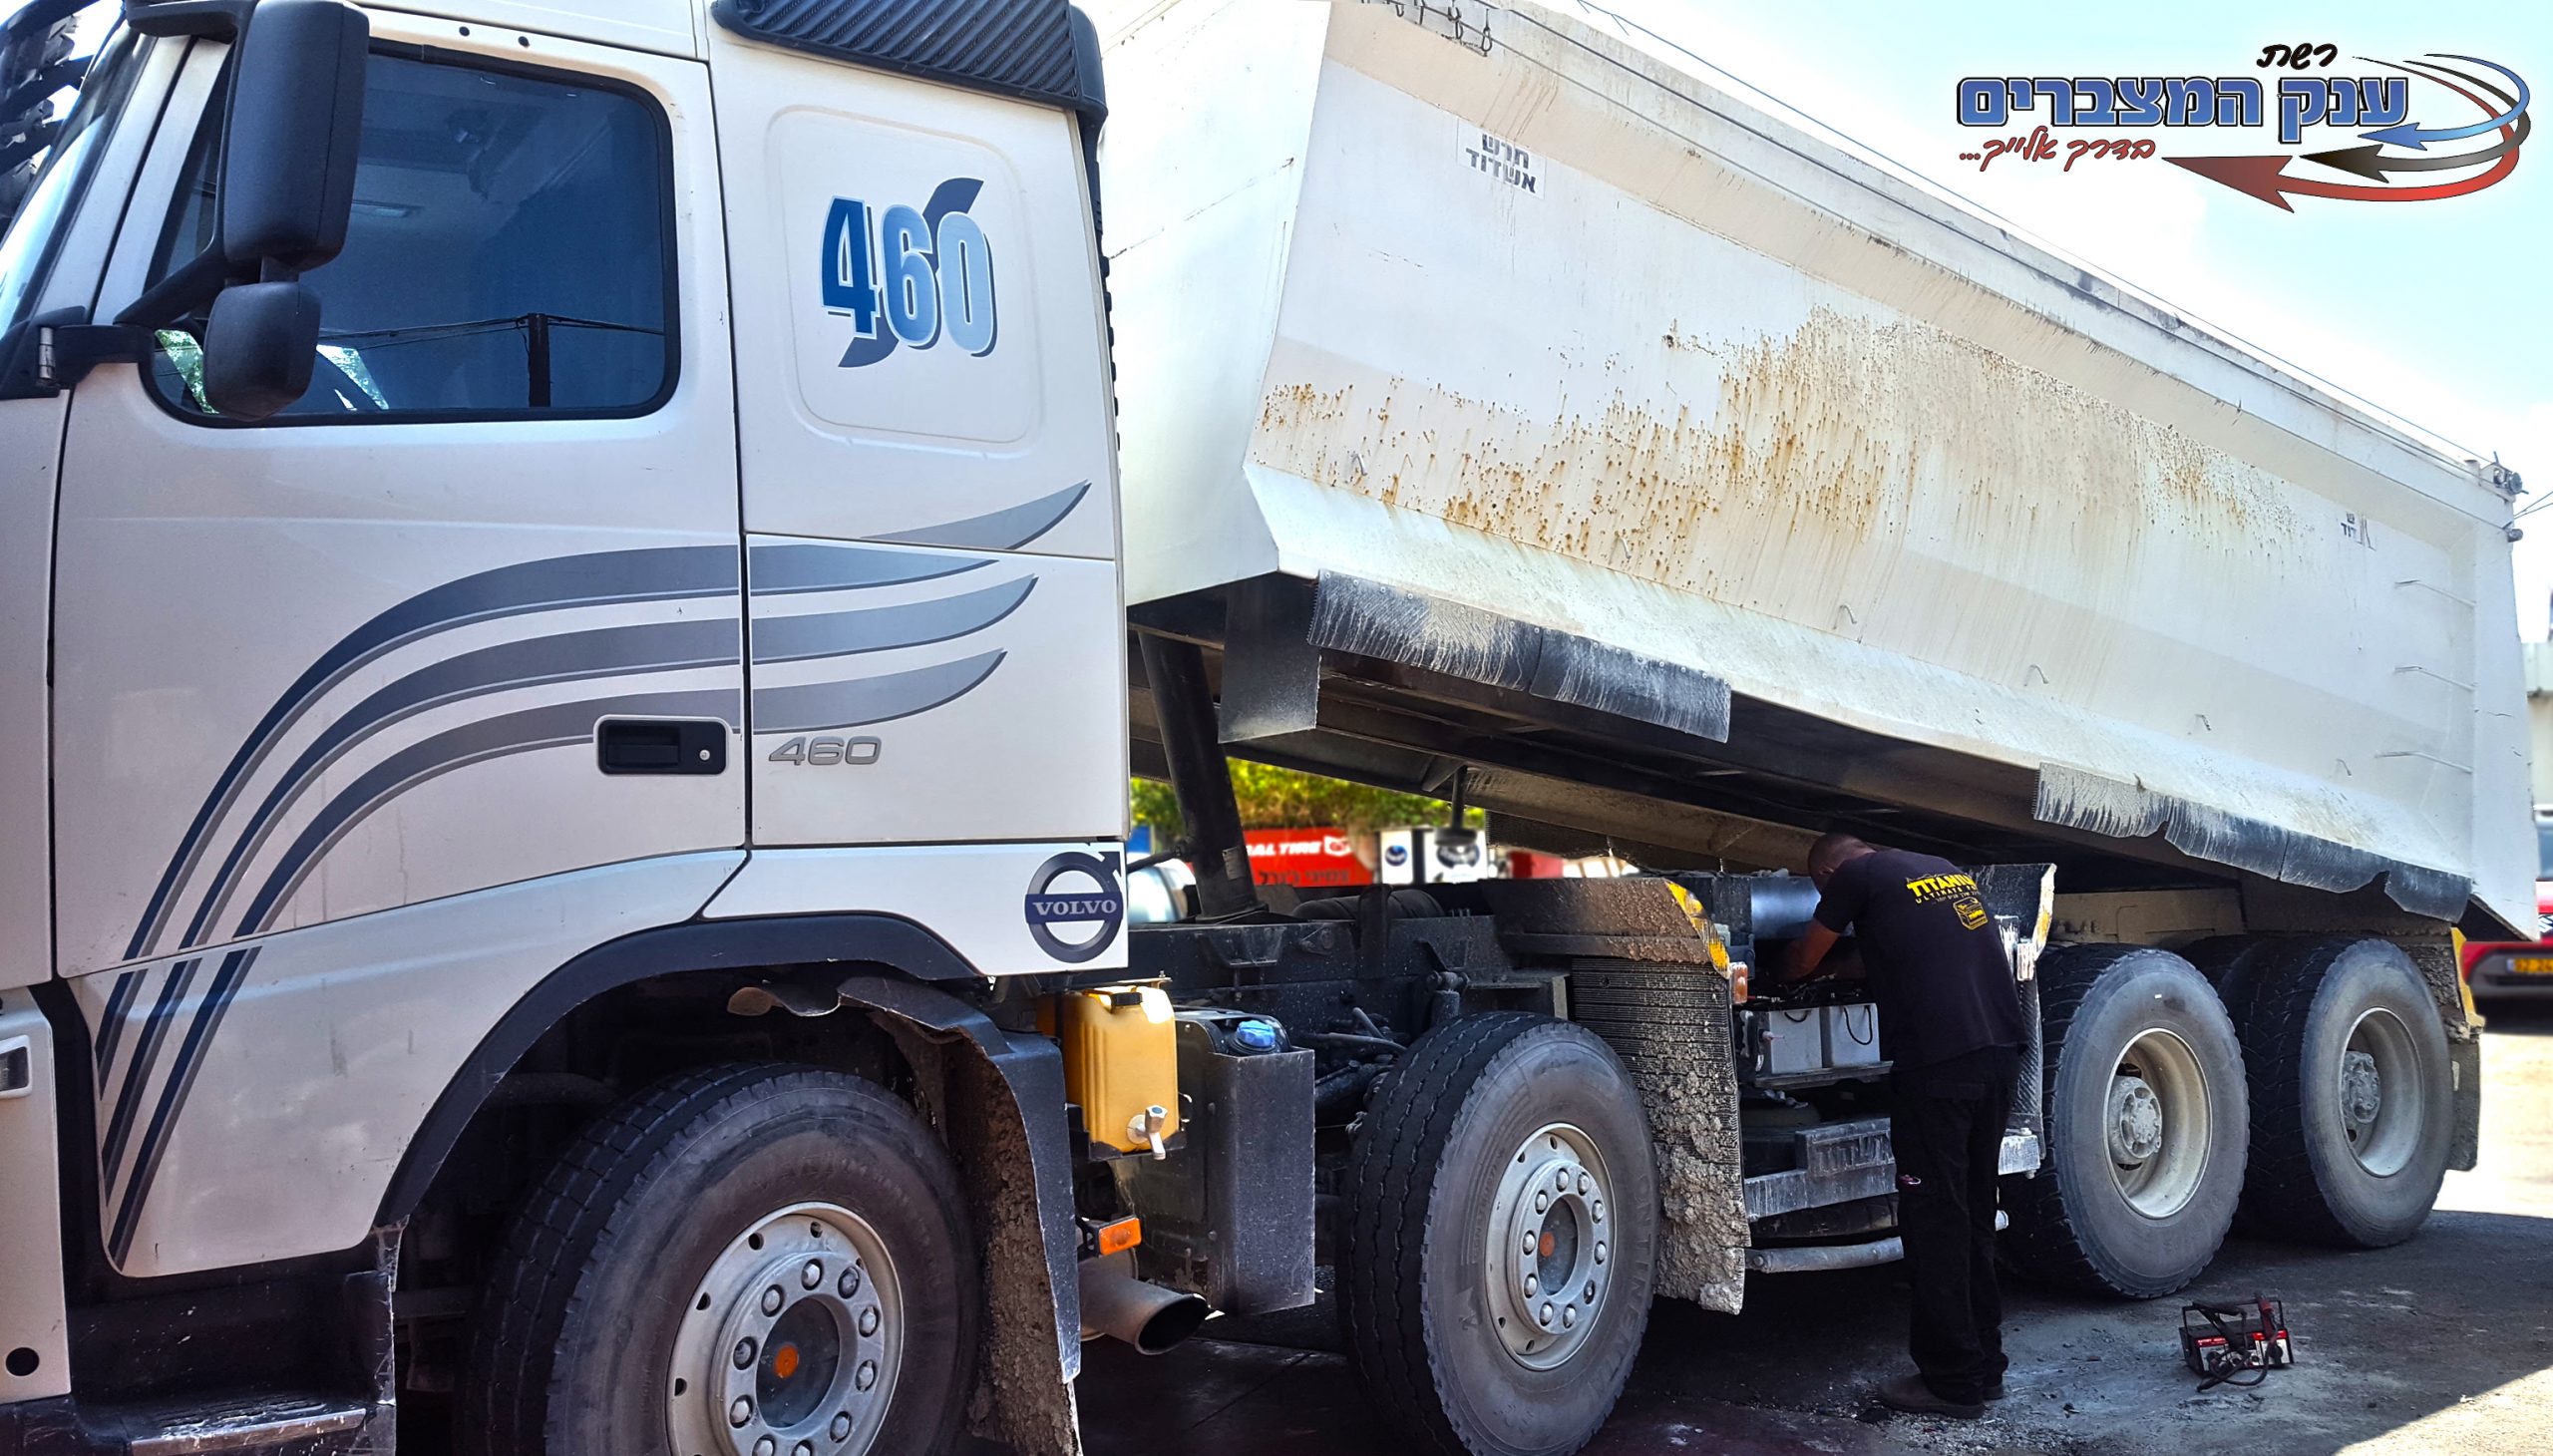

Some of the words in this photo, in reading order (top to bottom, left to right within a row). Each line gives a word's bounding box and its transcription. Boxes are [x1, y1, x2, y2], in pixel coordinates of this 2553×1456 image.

[1482, 134, 1529, 170] חרש
[1466, 148, 1536, 193] אשדוד
[819, 194, 997, 357] 460
[768, 736, 883, 766] 460
[1277, 840, 1322, 856] TIRE
[1907, 874, 1977, 897] TITANIU
[1032, 900, 1117, 915] VOLVO
